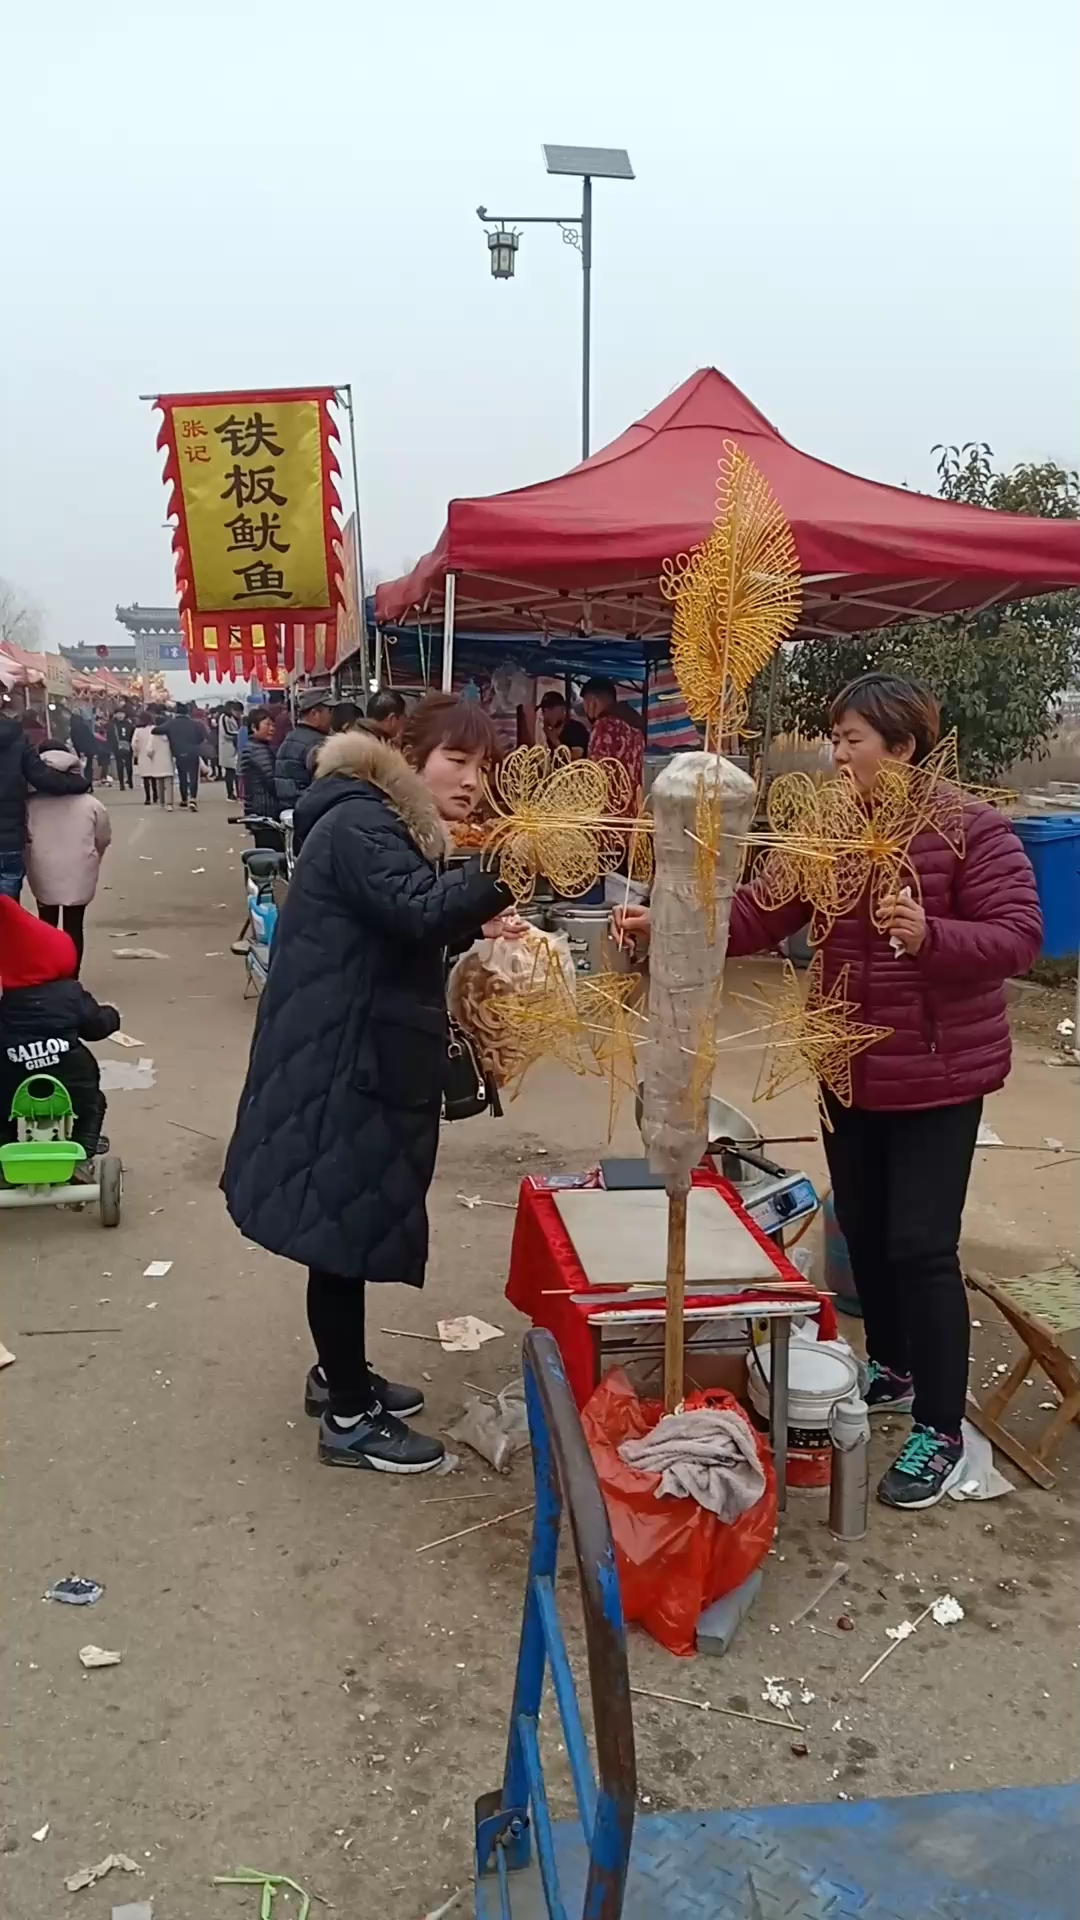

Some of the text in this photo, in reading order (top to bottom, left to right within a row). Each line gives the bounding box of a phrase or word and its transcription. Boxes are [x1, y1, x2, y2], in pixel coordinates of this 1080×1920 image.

[182, 419, 211, 463] 张记
[214, 412, 293, 601] 铁板鱿鱼
[25, 1054, 60, 1071] GIRLS
